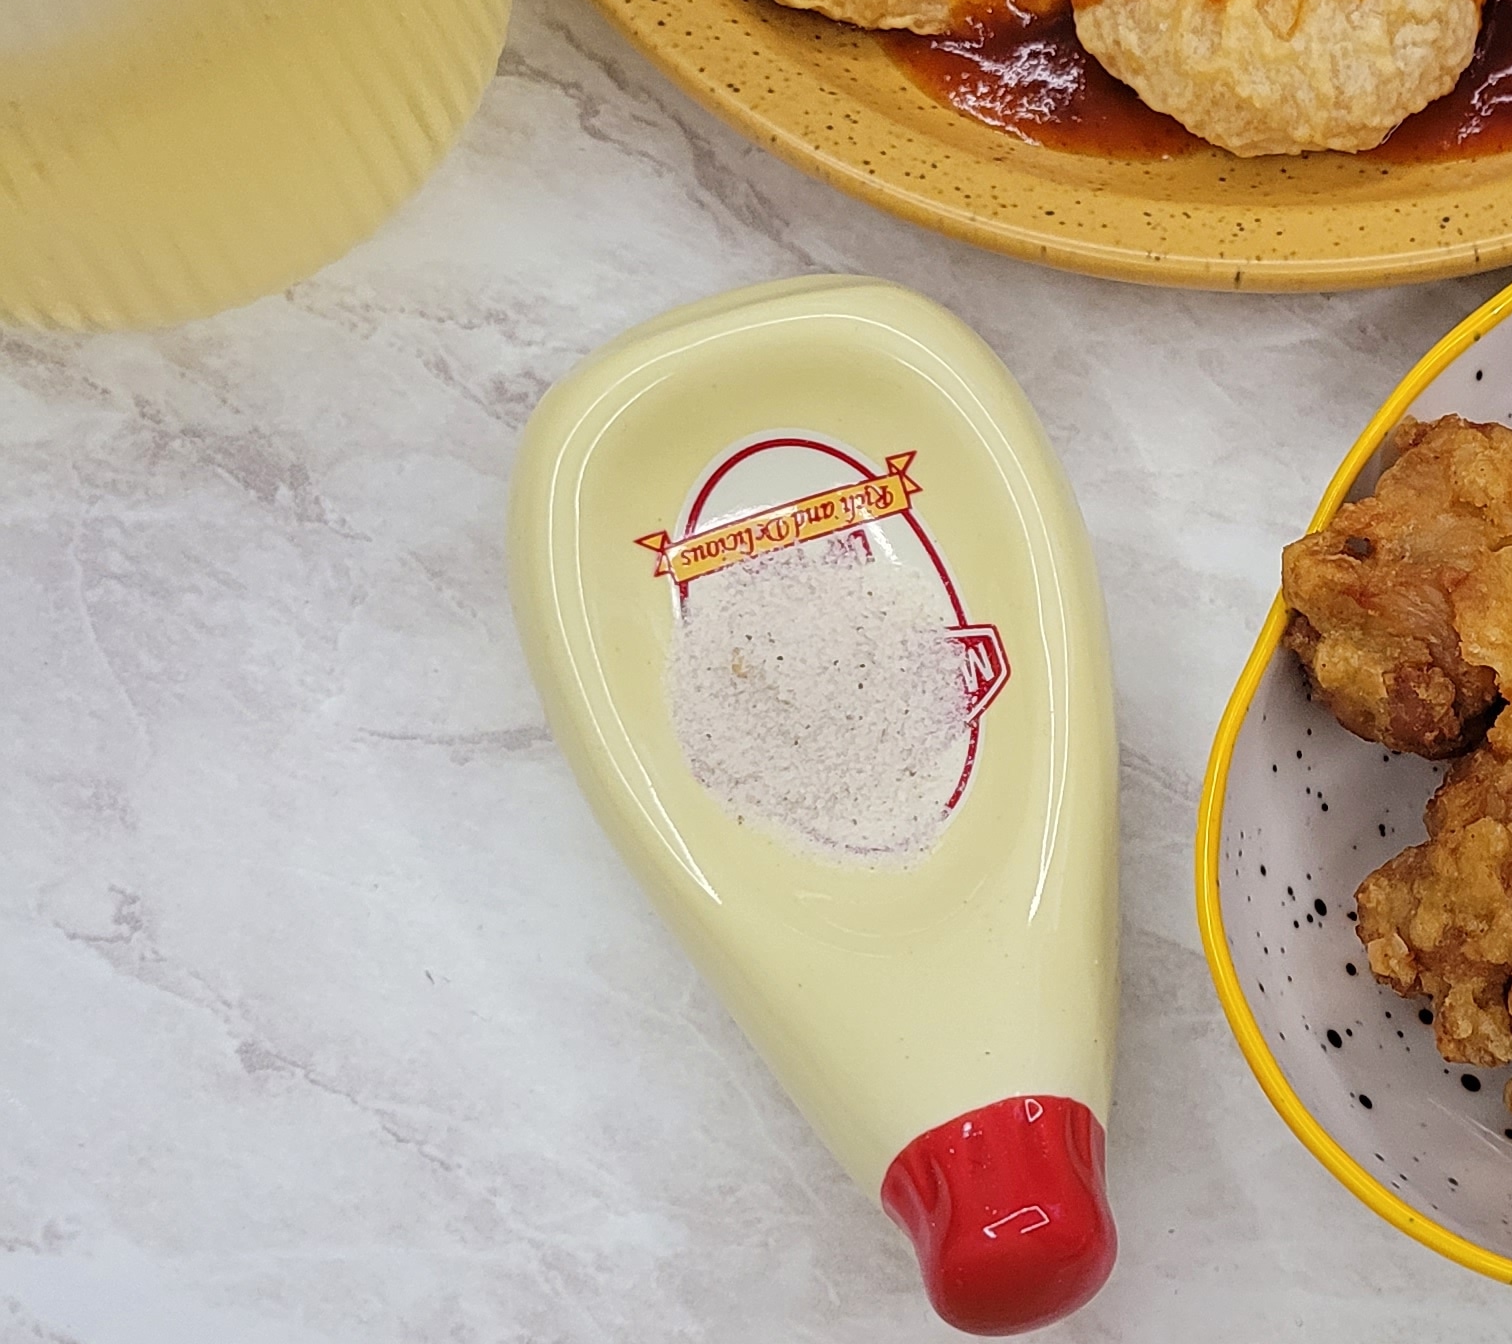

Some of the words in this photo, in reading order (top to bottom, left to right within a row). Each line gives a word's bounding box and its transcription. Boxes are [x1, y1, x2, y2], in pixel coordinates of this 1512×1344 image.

[792, 501, 838, 537] and
[840, 484, 894, 523] Rich
[680, 517, 790, 567] Delicious
